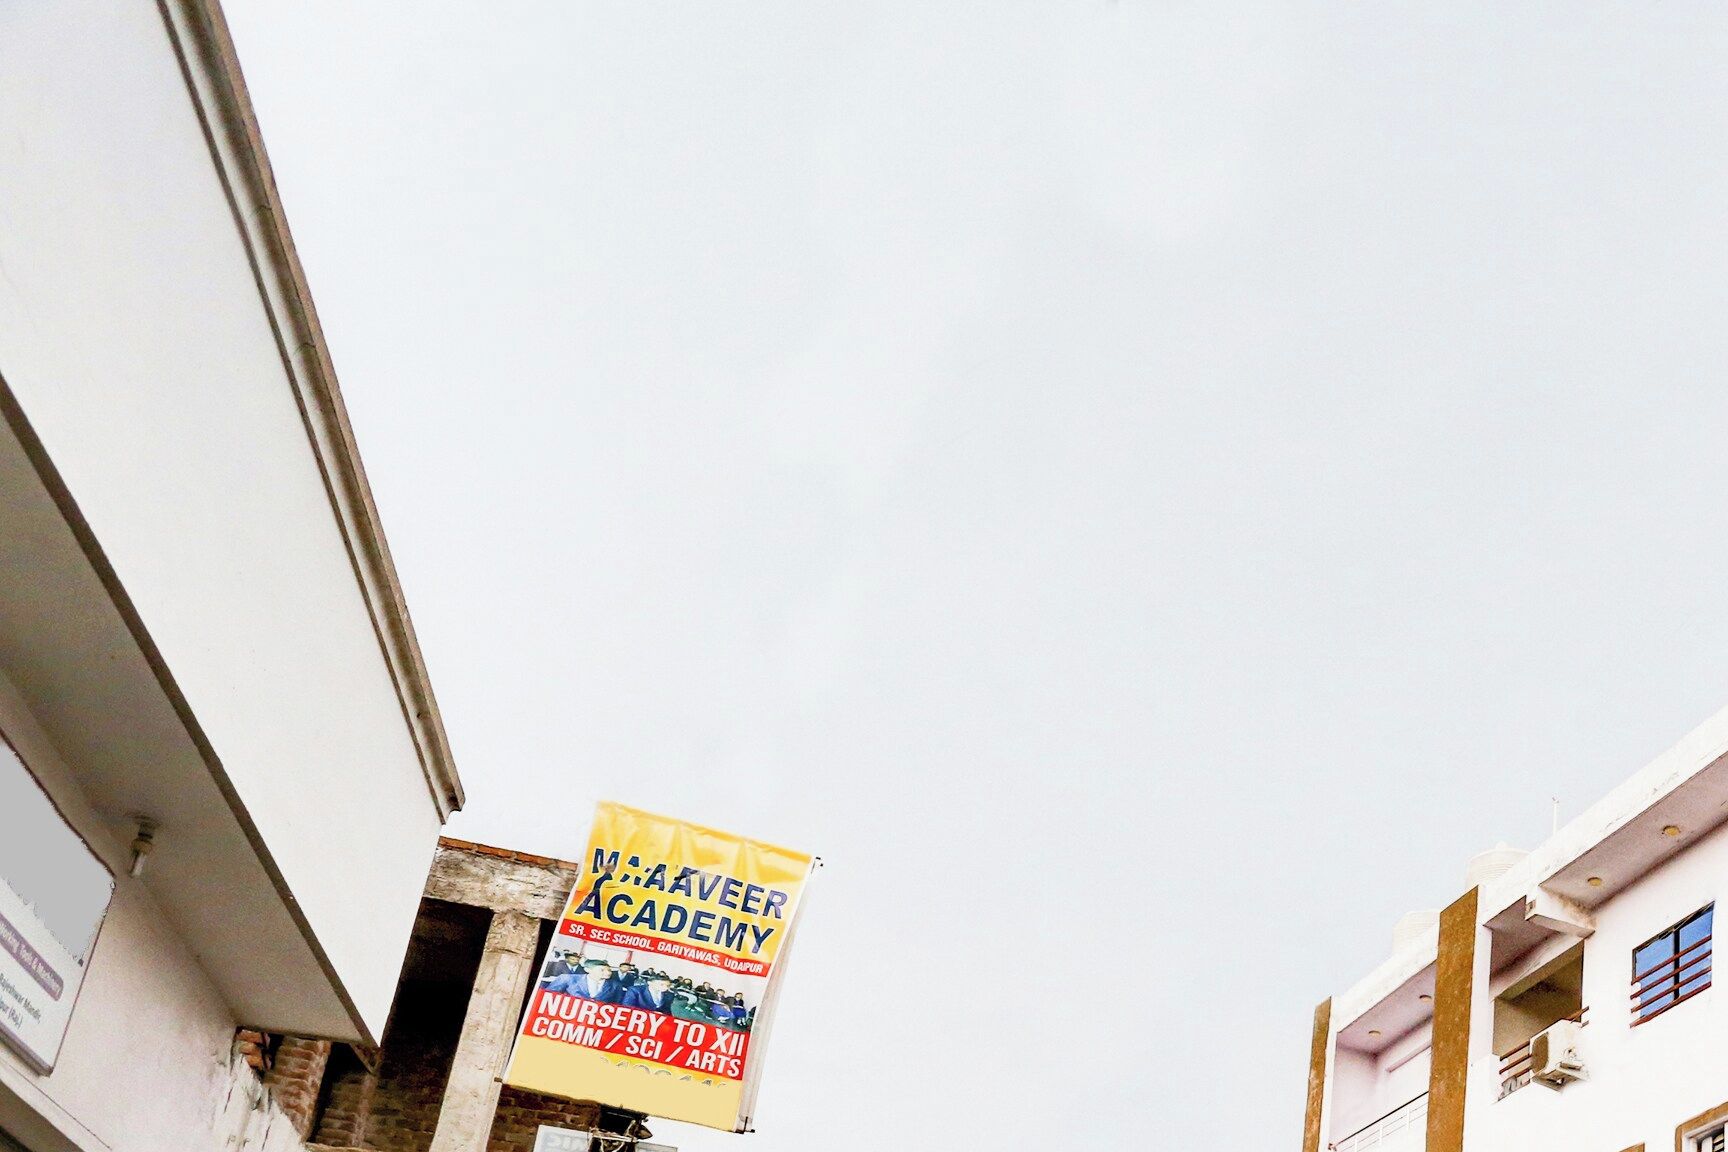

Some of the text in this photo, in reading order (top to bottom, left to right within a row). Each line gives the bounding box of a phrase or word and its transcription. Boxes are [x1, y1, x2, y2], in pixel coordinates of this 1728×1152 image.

[569, 923, 586, 937] SR.
[589, 929, 611, 943] SEC
[724, 958, 763, 974] UDAIPUR
[575, 889, 774, 954] ACADEMY
[531, 1016, 603, 1048] COMM
[625, 1035, 662, 1060] SCI
[685, 1050, 741, 1078] ARTS
[538, 991, 745, 1056] NURSERY TO XII
